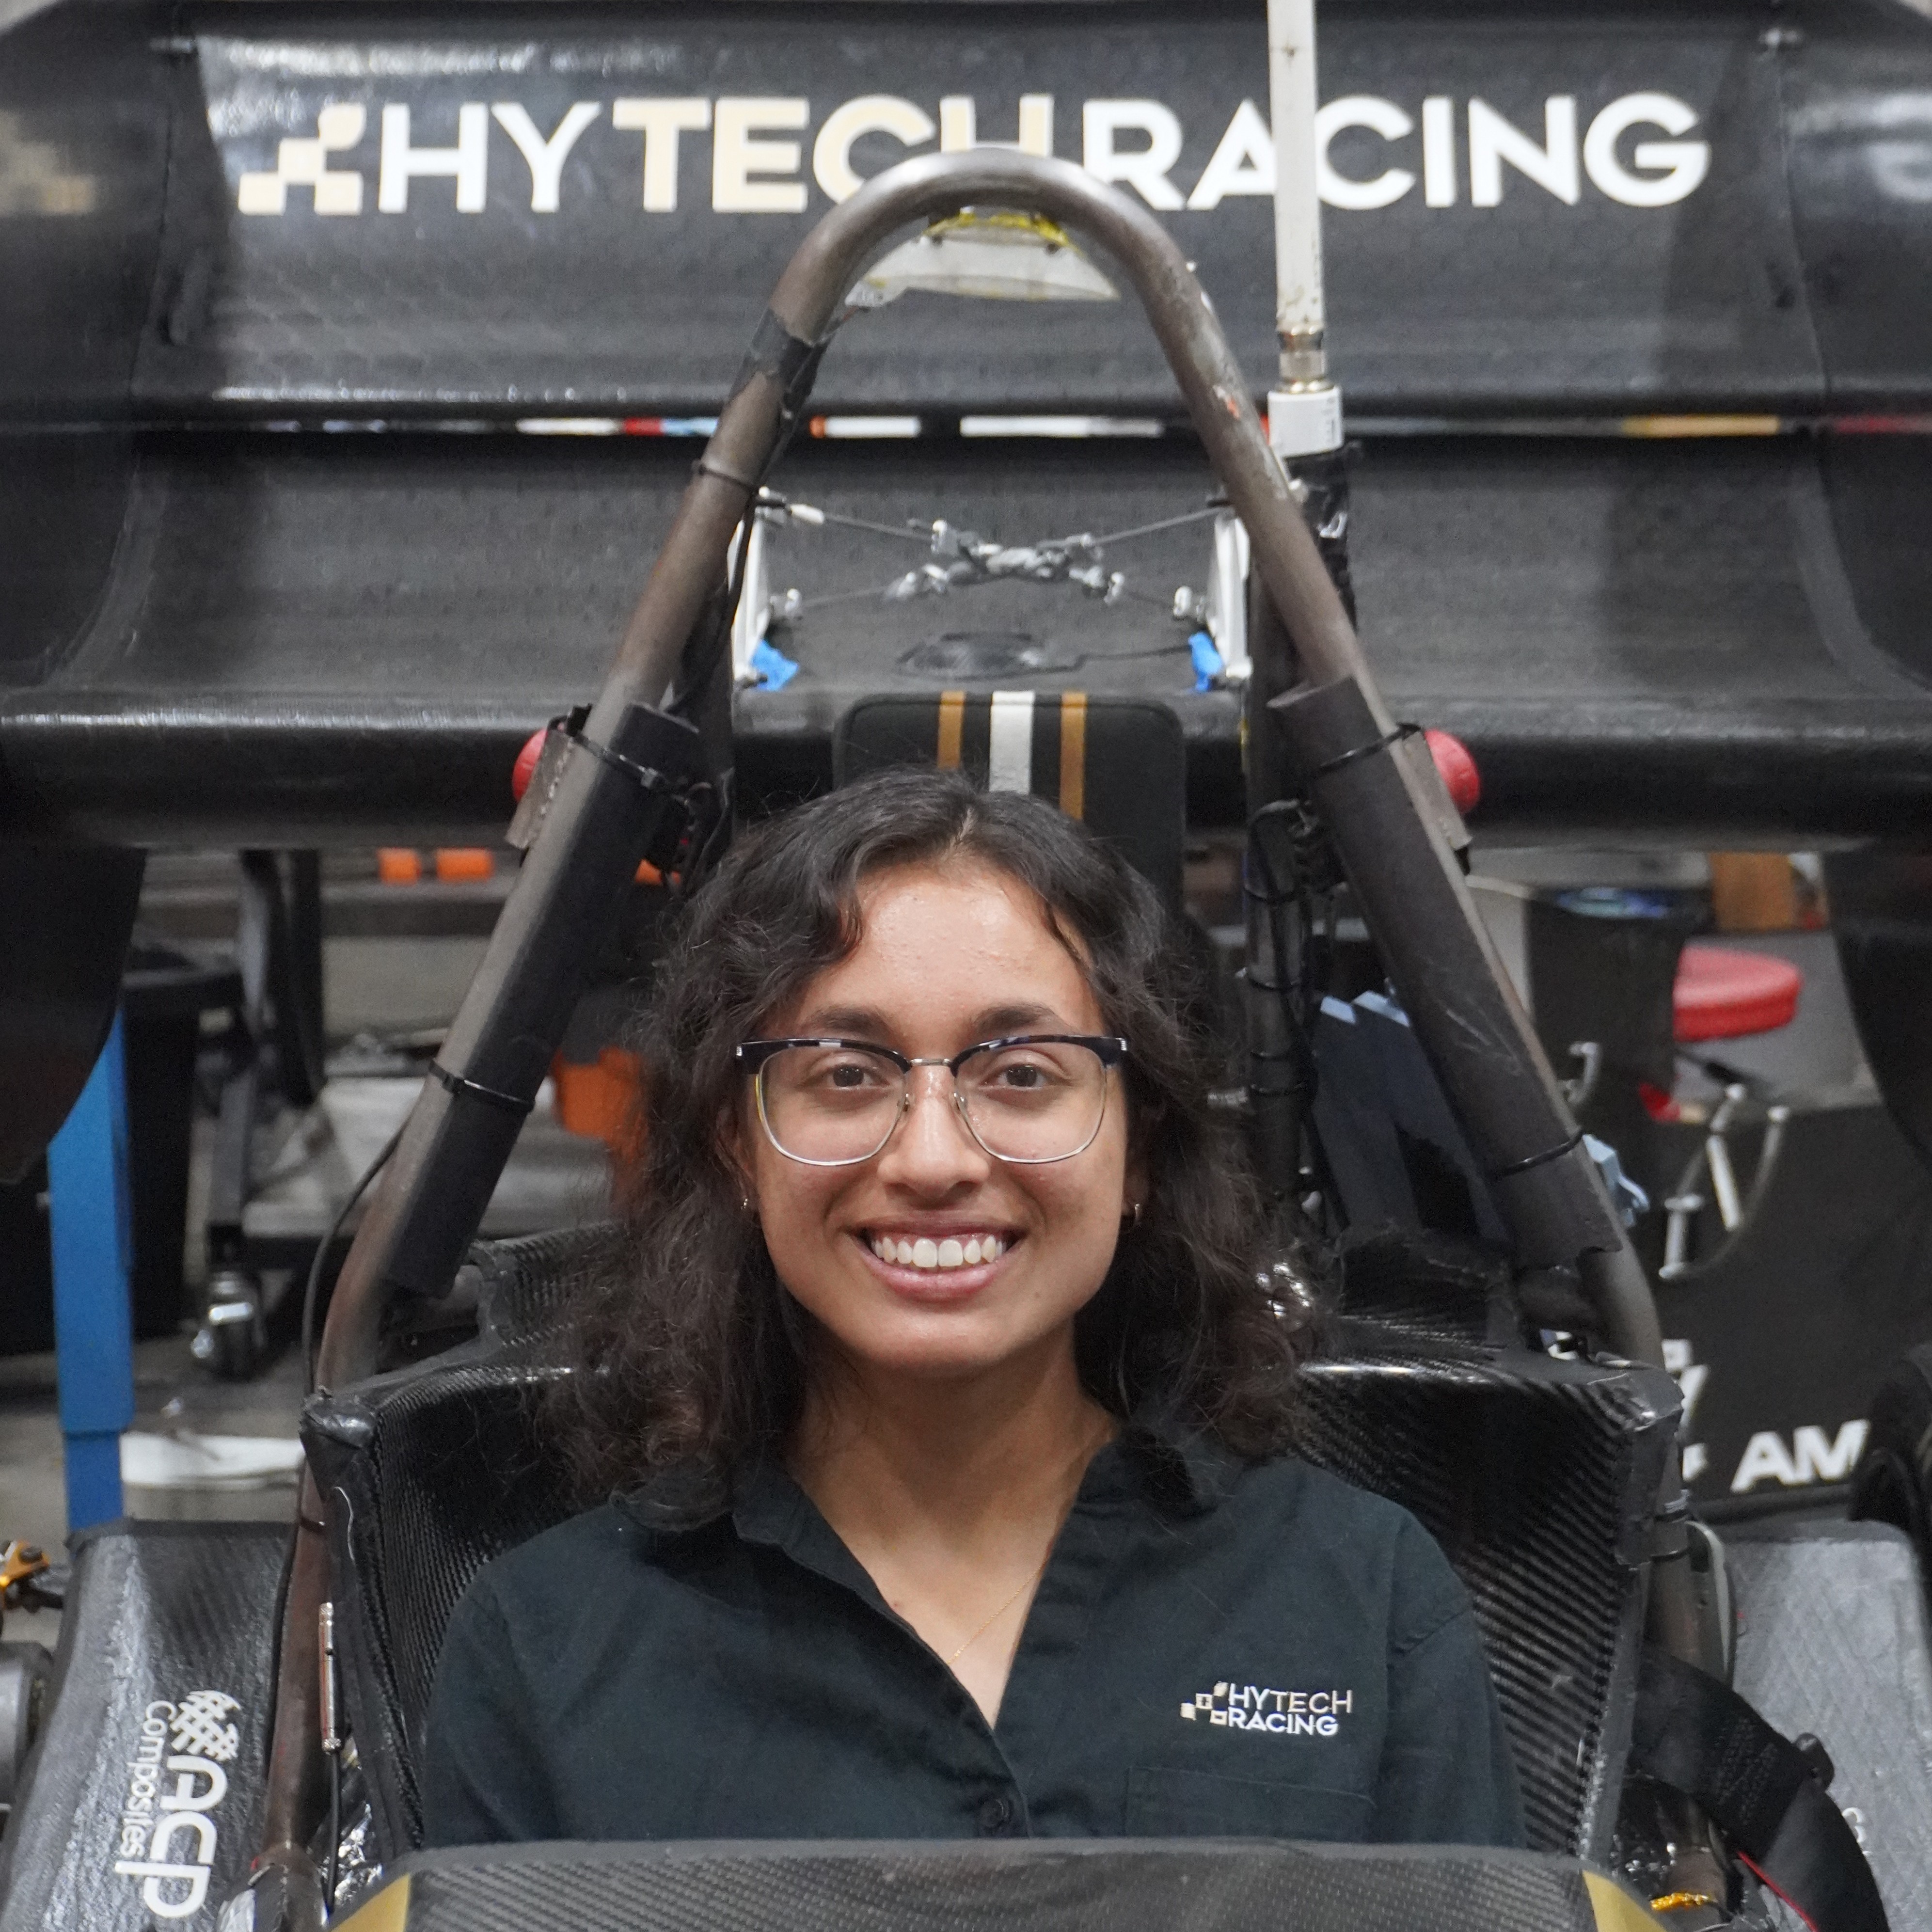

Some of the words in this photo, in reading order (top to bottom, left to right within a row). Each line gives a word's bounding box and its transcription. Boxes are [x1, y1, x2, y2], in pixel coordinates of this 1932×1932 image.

[1082, 91, 1710, 211] RACING
[1228, 1706, 1339, 1737] RACING
[1229, 1683, 1353, 1714] HYTECH
[114, 1755, 228, 1918] ACP
[120, 1699, 177, 1858] Composites
